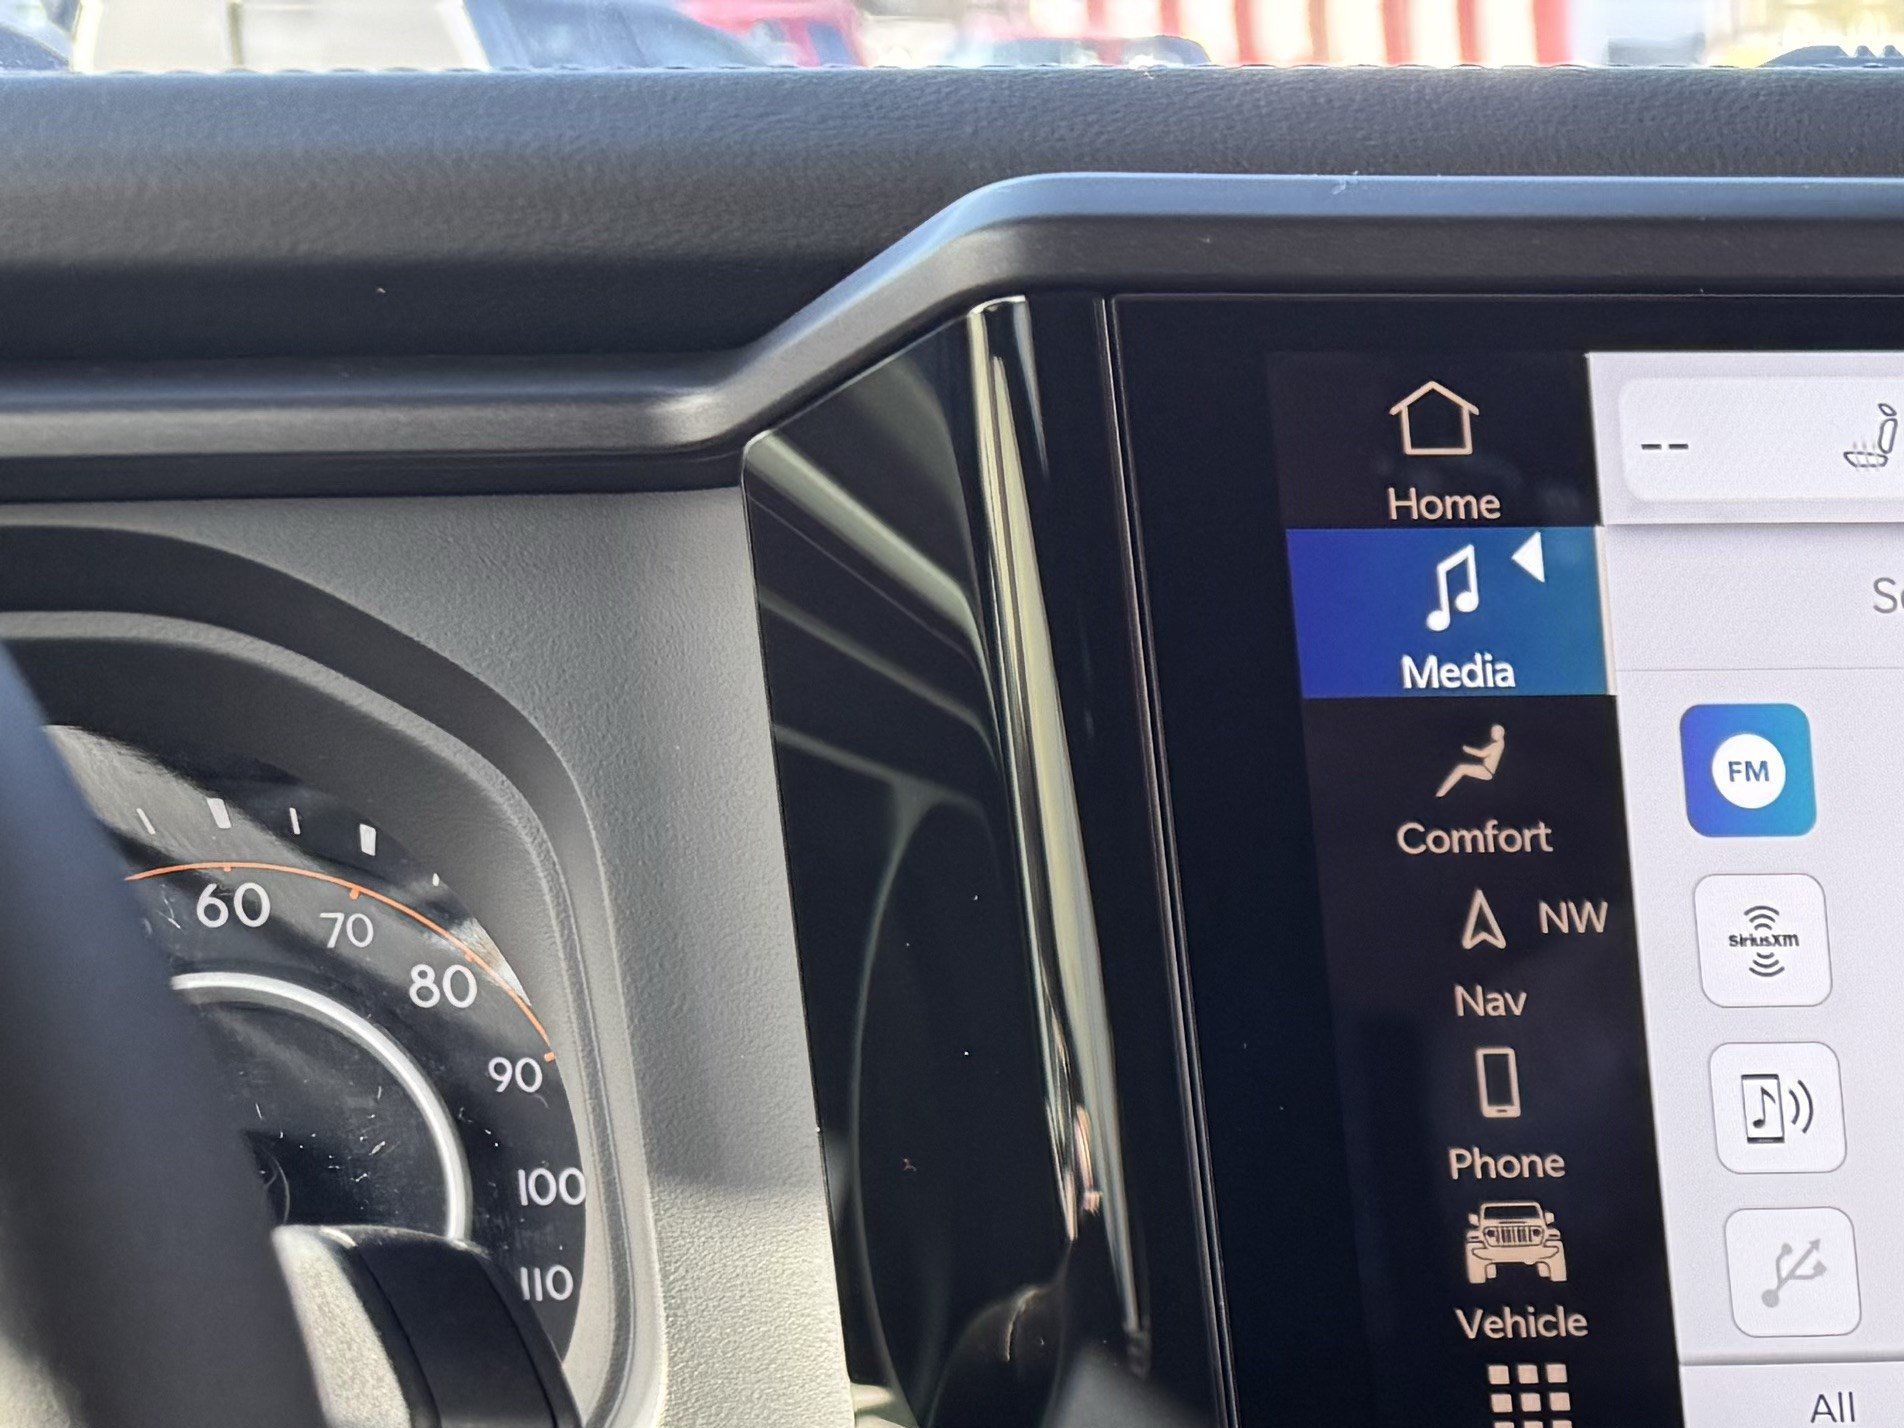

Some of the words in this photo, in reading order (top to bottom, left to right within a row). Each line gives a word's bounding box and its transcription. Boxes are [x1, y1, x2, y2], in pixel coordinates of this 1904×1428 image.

[1388, 486, 1501, 522] Home
[1401, 655, 1516, 690] Media
[1727, 760, 1770, 783] FM
[1395, 820, 1555, 858] Comfort
[196, 883, 271, 929] 60
[1538, 901, 1608, 935] NW
[319, 911, 375, 949] 70
[408, 964, 478, 1008] 80
[1453, 984, 1528, 1018] Nav
[487, 1056, 543, 1094] 90
[1448, 1148, 1566, 1181] Phone
[516, 1166, 587, 1207] 100
[519, 1264, 574, 1302] 110
[1454, 1305, 1590, 1341] Vehicle
[1809, 1391, 1857, 1425] All
